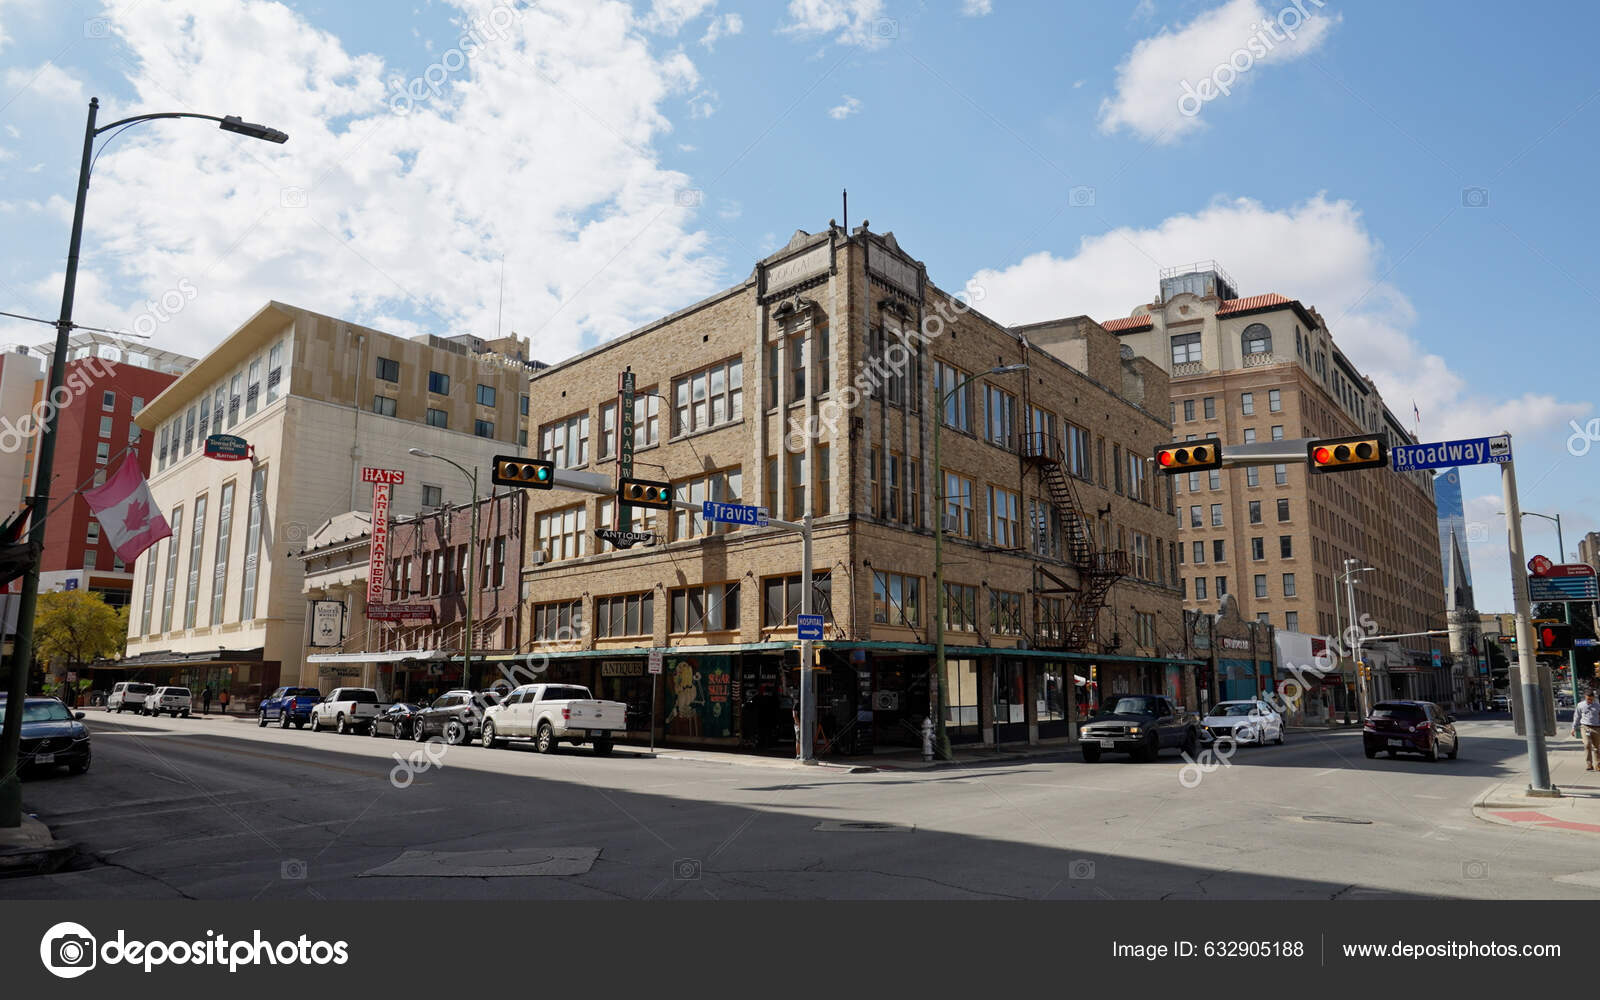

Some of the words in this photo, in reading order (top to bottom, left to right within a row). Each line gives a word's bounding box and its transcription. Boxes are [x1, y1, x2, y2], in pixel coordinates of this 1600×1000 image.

[623, 399, 633, 478] BROADW
[1396, 442, 1484, 466] Broadway
[365, 468, 403, 483] HATS
[376, 485, 388, 526] PARIS
[706, 503, 711, 511] E
[712, 503, 754, 522] Travis
[602, 530, 648, 541] ANTIQUE
[372, 535, 385, 593] HATTERS
[603, 662, 642, 675] ANTIQUES
